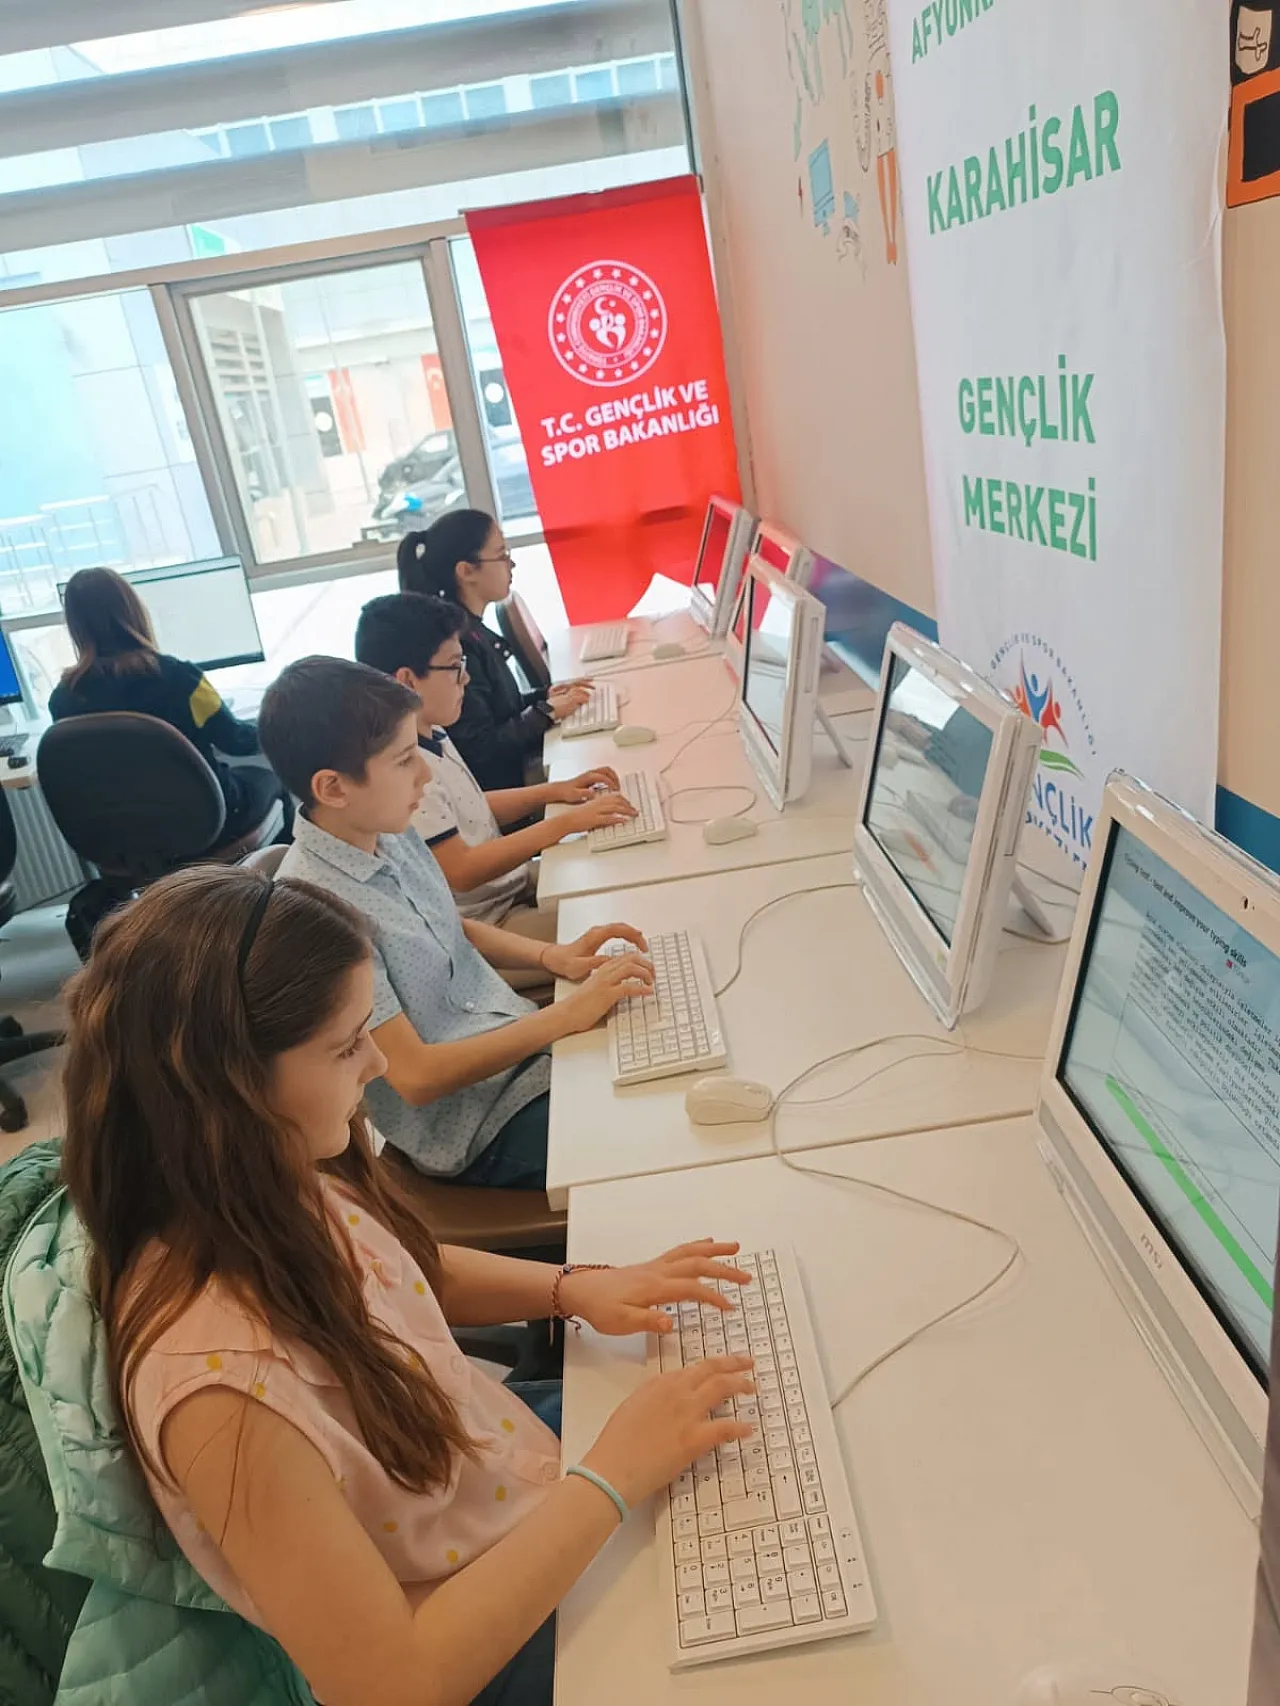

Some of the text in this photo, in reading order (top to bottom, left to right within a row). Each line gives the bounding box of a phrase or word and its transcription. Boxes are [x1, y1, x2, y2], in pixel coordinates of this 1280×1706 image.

[926, 90, 1121, 234] KARAHİSAR
[540, 379, 709, 438] T.C. GENÇLİK VE
[540, 402, 720, 466] SPOR BAKANLIĞI
[958, 355, 1096, 447] GENÇLİK
[962, 475, 1097, 561] MERKEZİ
[1210, 929, 1230, 954] typing
